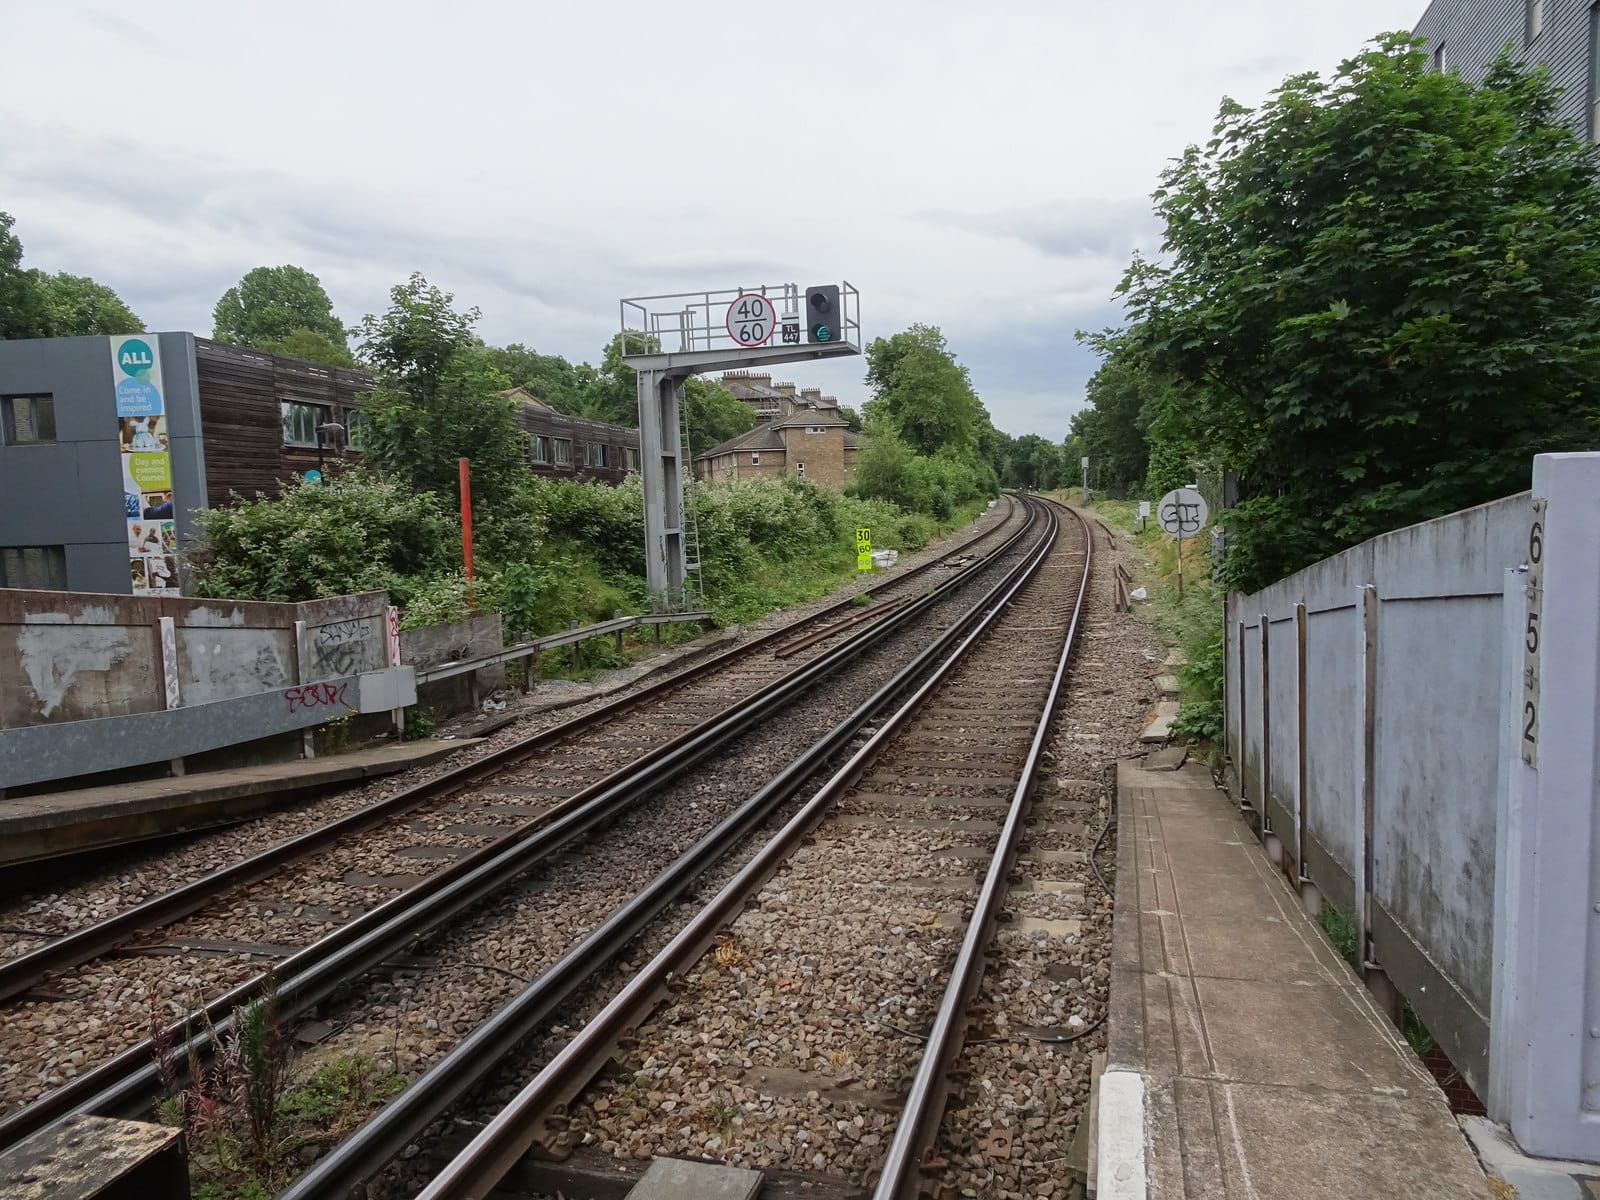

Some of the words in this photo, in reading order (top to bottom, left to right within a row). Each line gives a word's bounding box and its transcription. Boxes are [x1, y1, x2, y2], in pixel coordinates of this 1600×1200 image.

[737, 299, 763, 319] 40
[739, 322, 764, 342] 60
[785, 325, 795, 333] TL
[783, 332, 798, 341] 447
[122, 351, 152, 365] ALL
[119, 386, 141, 394] Come
[143, 386, 151, 394] in
[120, 395, 135, 403] and
[136, 395, 147, 403] be
[120, 404, 153, 415] inspired
[135, 458, 149, 467] Day
[135, 467, 165, 475] evening
[857, 530, 870, 541] 30
[859, 544, 871, 553] 60
[1529, 521, 1542, 565] 6
[1525, 613, 1538, 654] 5
[1523, 700, 1536, 744] 2
